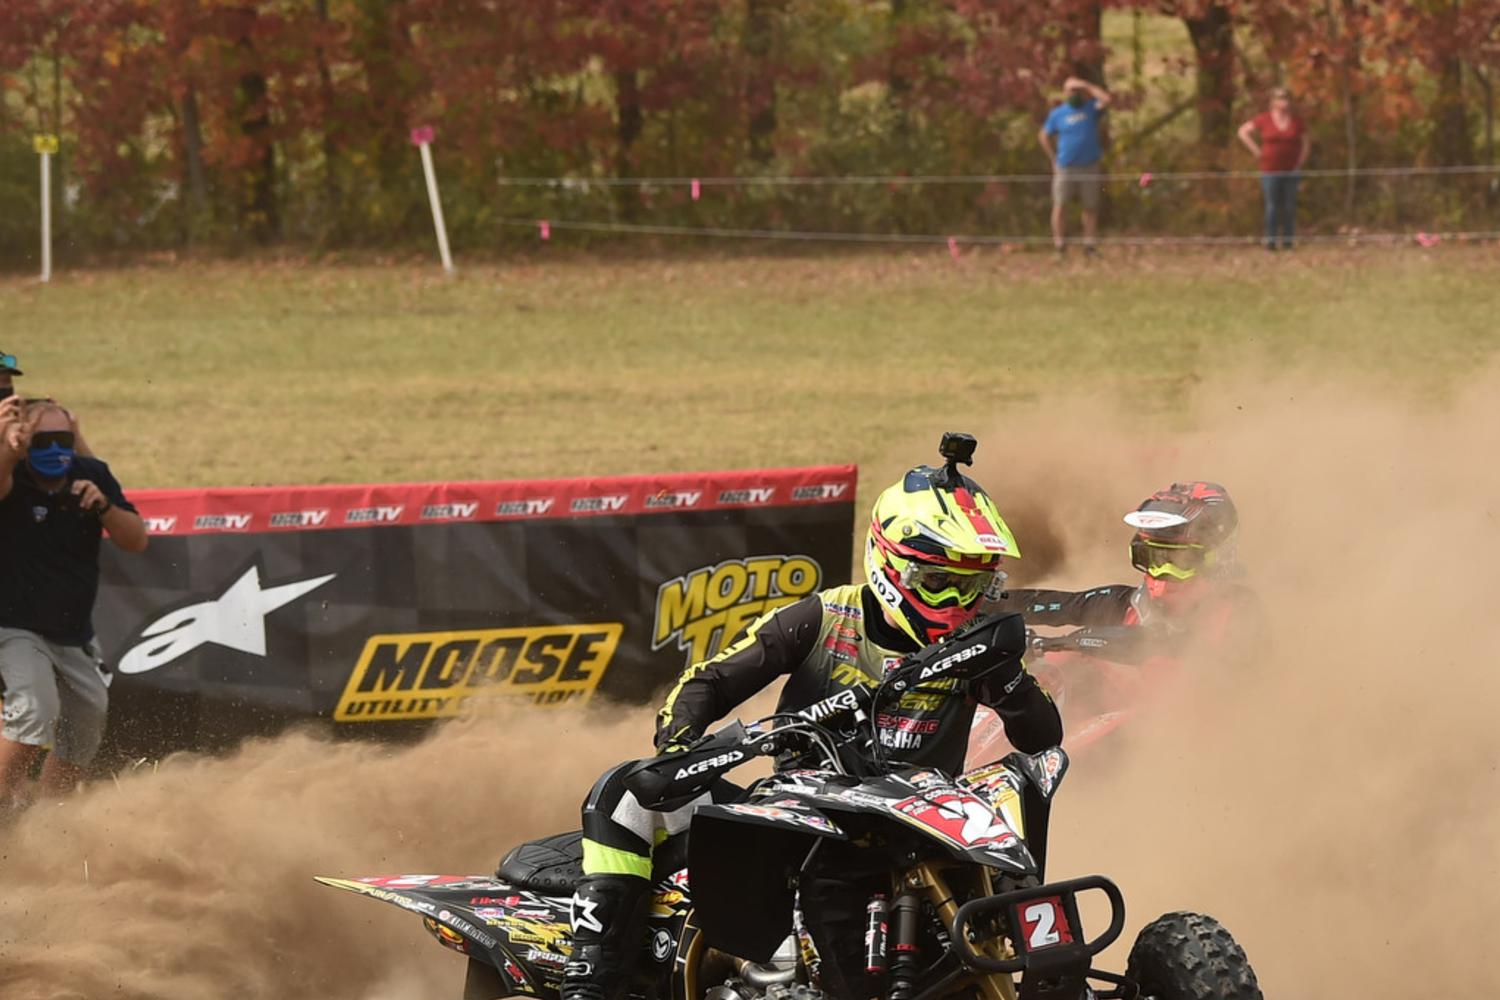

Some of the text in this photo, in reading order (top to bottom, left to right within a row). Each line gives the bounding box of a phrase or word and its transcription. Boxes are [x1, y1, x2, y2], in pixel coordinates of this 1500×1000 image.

[655, 557, 820, 644] MOTO
[871, 570, 897, 608] 002
[356, 632, 608, 693] MOOSE
[919, 643, 988, 680] ACERBIS
[799, 688, 857, 722] Mika
[674, 750, 743, 780] ACERBIS
[1024, 902, 1060, 949] 2
